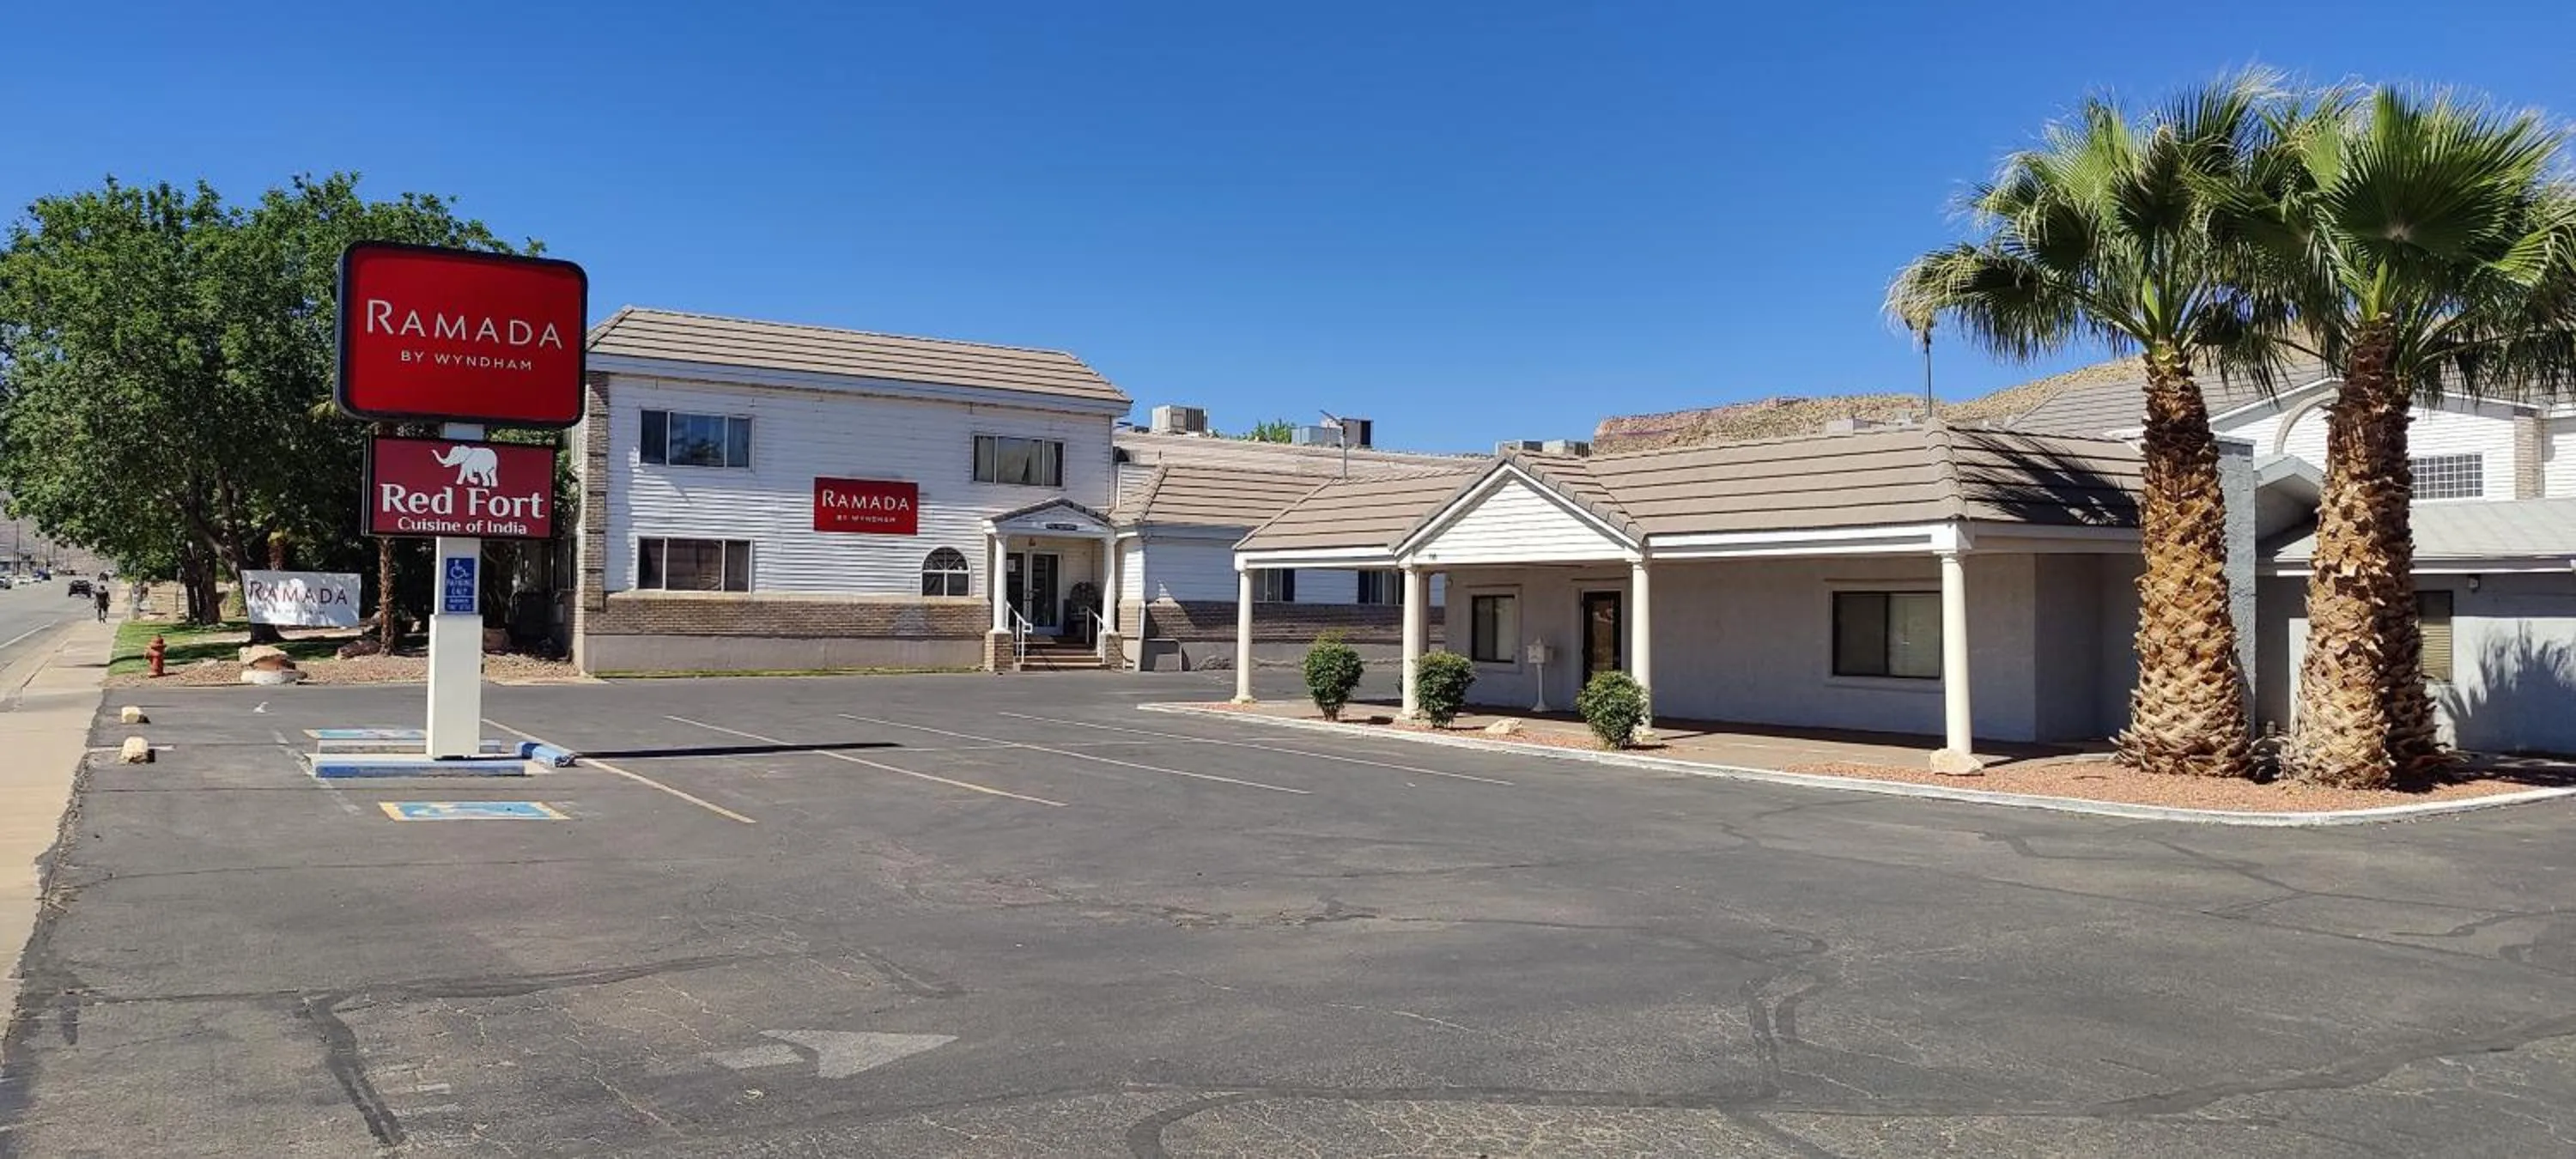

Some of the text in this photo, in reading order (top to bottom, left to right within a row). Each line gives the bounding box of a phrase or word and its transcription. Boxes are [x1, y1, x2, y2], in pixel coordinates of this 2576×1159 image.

[367, 298, 563, 350] RAMADA
[400, 349, 532, 371] BY WYNDHAM
[379, 483, 545, 519] Red Fort
[822, 488, 910, 511] RAMADA
[398, 516, 527, 535] Cuisine of India
[248, 580, 349, 605] RAMADA
